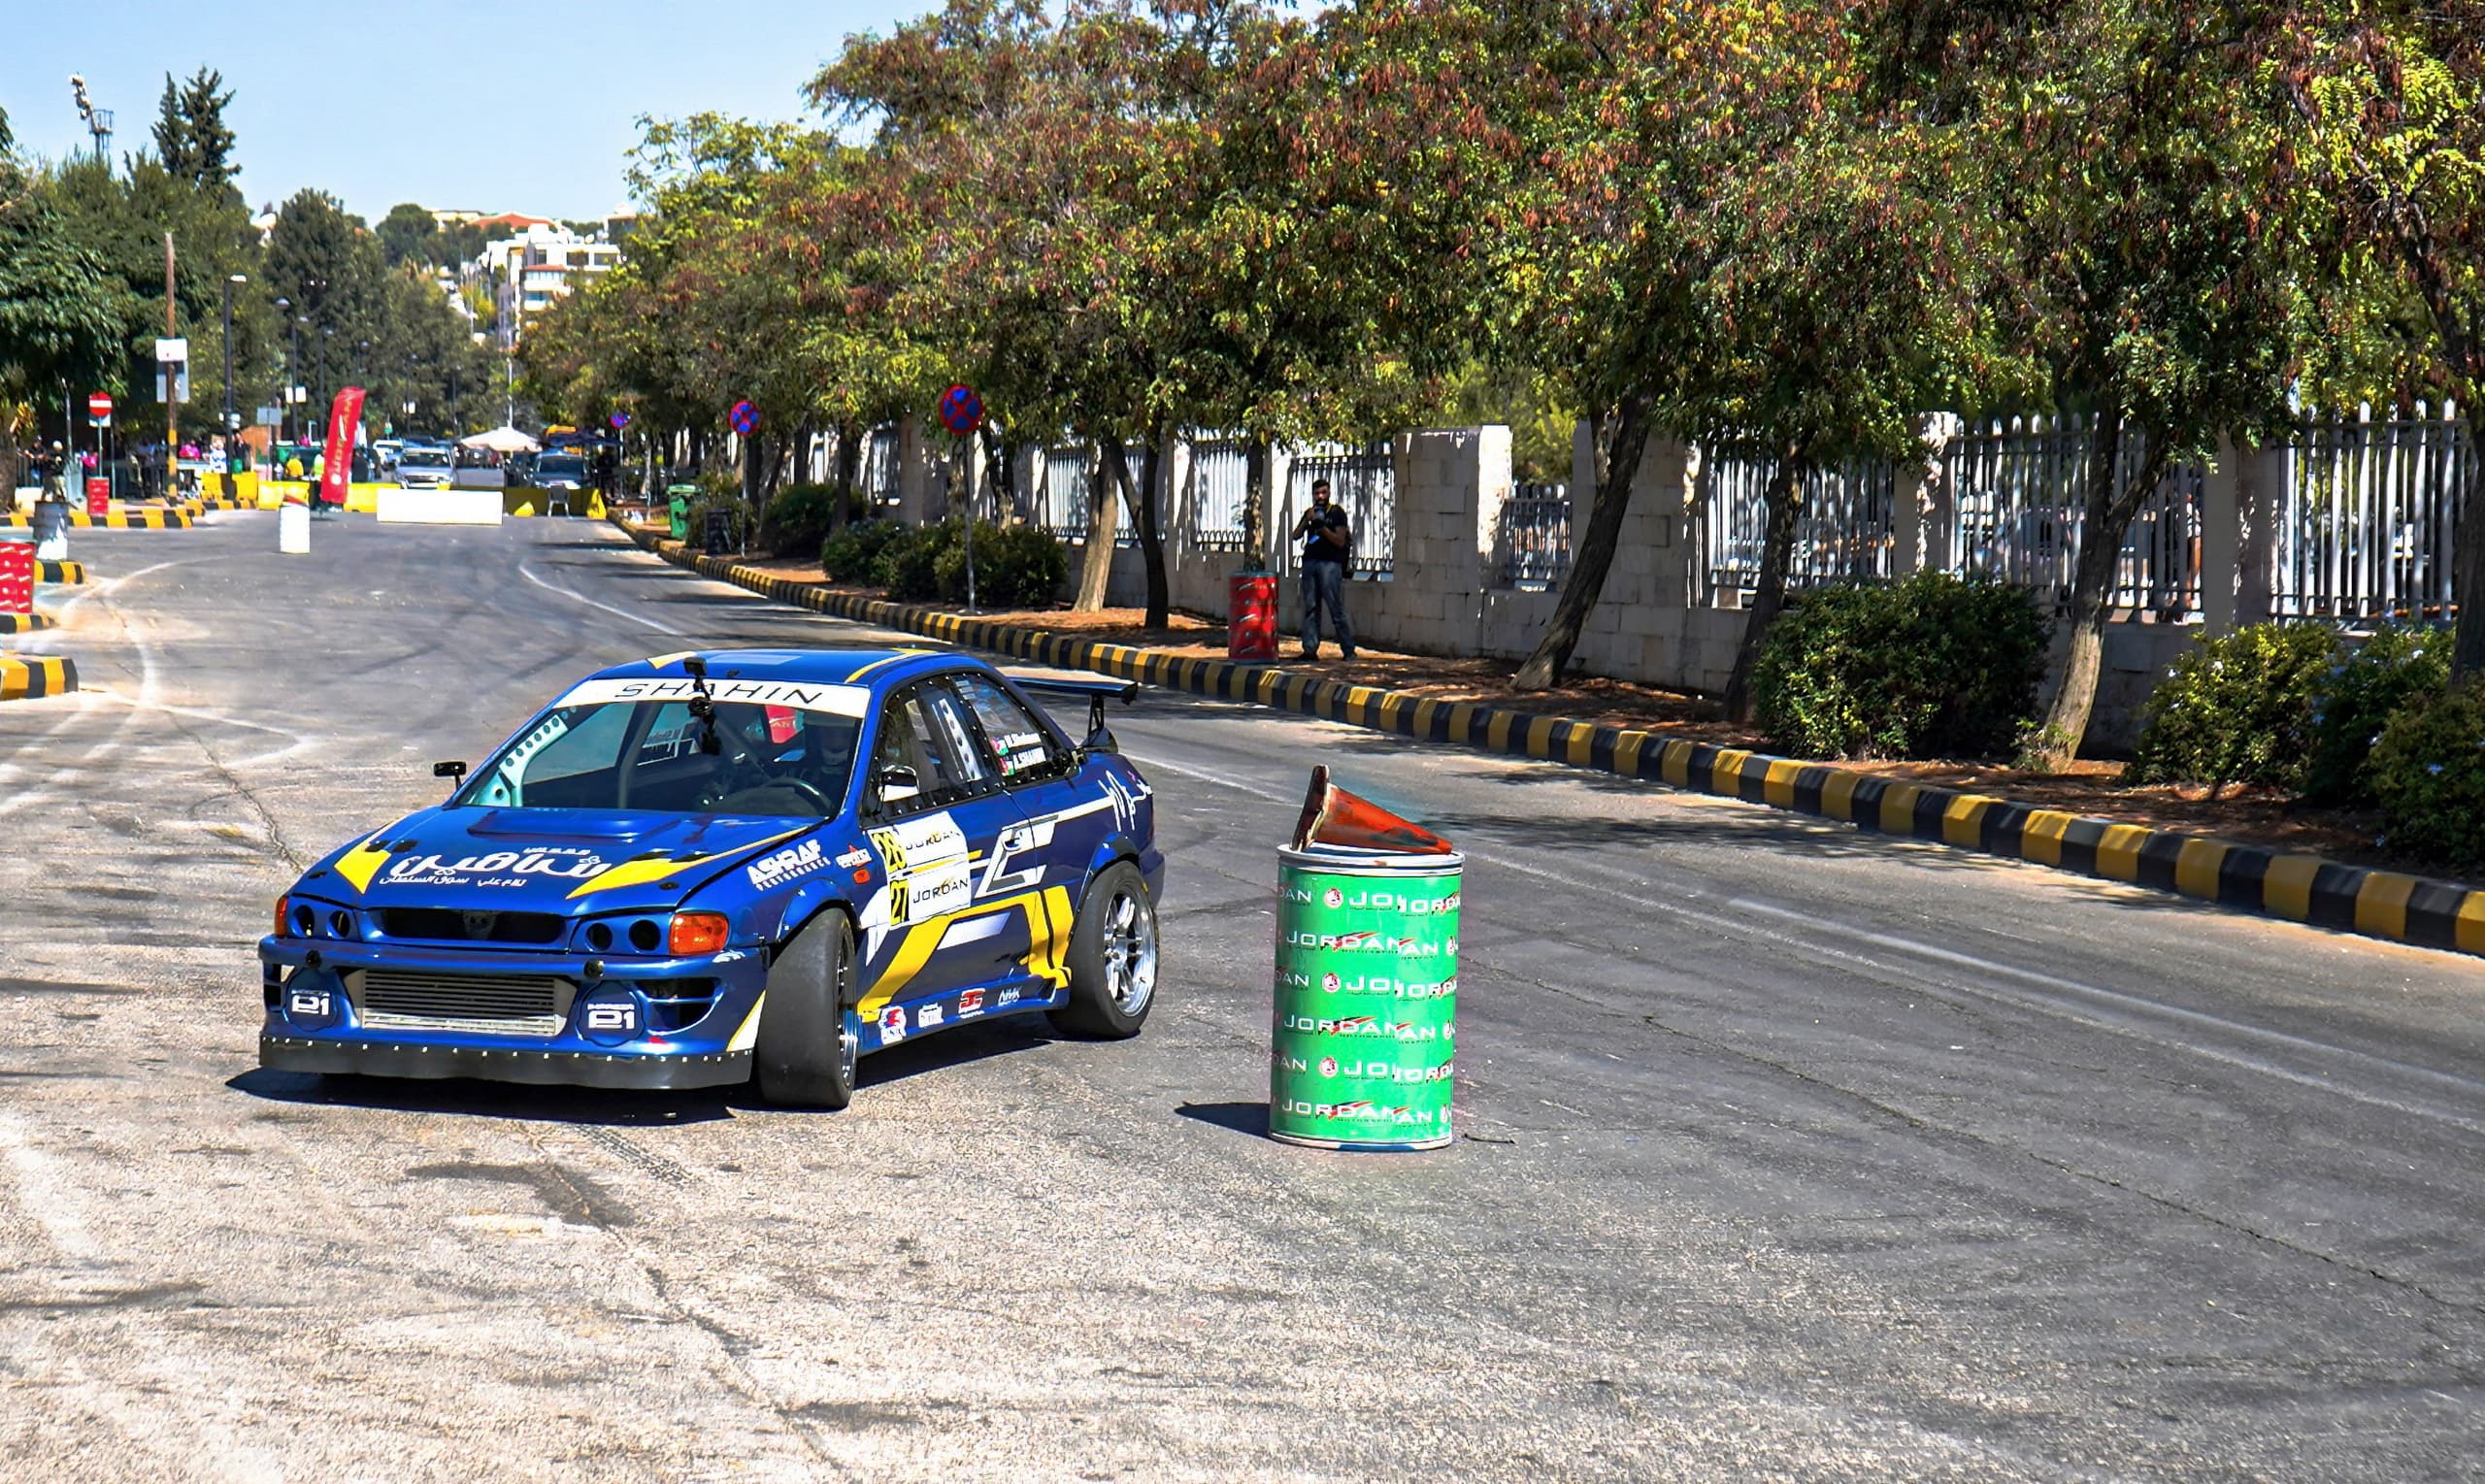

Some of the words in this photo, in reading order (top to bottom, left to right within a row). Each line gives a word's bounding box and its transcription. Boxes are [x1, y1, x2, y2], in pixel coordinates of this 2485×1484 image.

[390, 852, 613, 878] شاهين
[747, 839, 821, 884] ASHRAF
[913, 877, 969, 904] JORDAN
